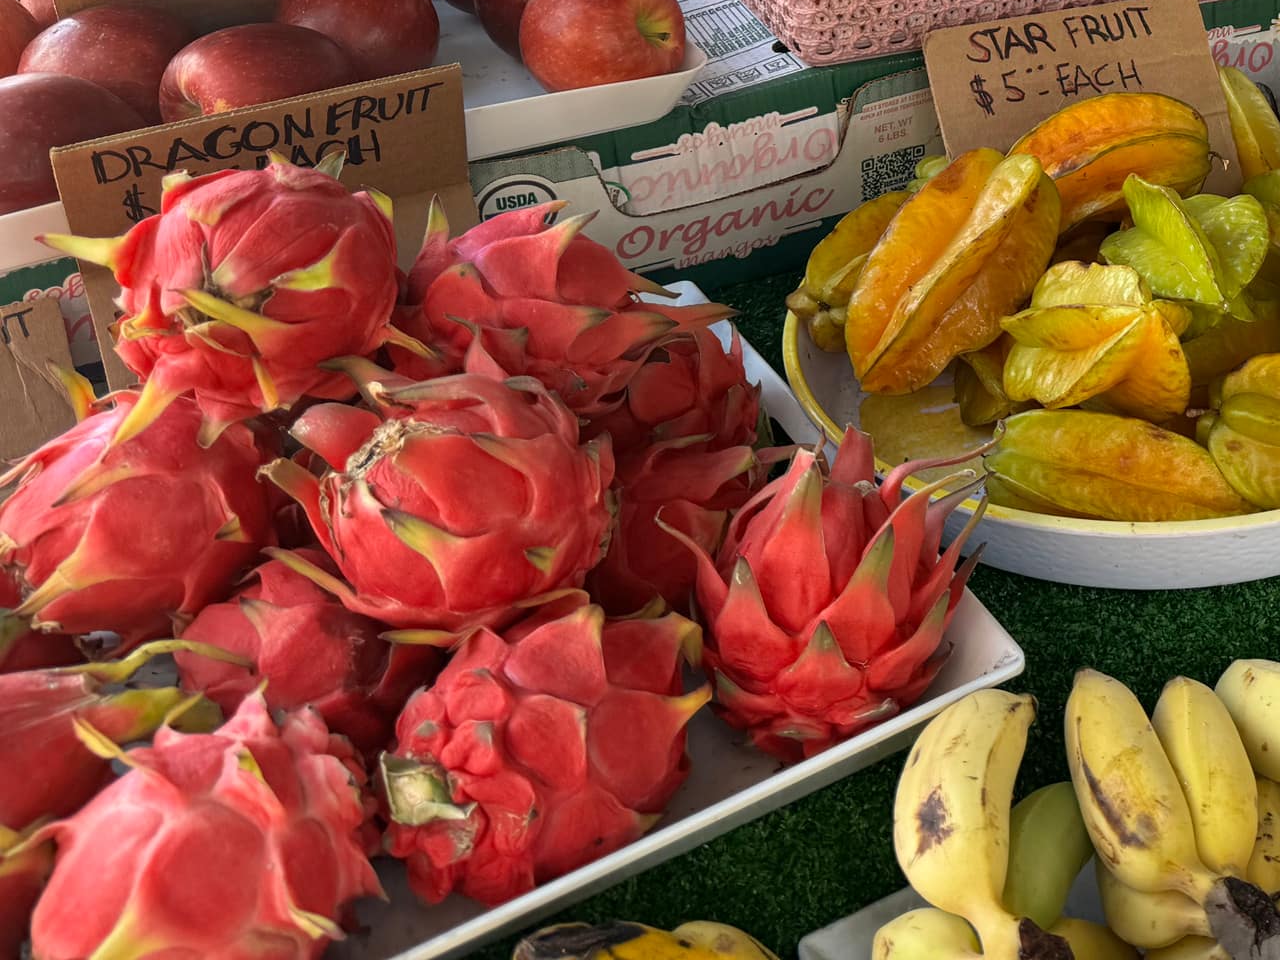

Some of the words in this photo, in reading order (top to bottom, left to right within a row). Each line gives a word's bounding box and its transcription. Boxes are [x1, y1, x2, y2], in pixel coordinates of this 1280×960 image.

[966, 21, 1057, 64] STAR
[1062, 6, 1152, 49] FRUIT
[1056, 58, 1143, 97] EACH
[90, 113, 313, 185] DRAGON
[326, 81, 446, 136] FRUIT
[897, 116, 913, 128] WT
[627, 126, 838, 206] Organic
[495, 191, 539, 211] USDA
[616, 187, 836, 260] Organic
